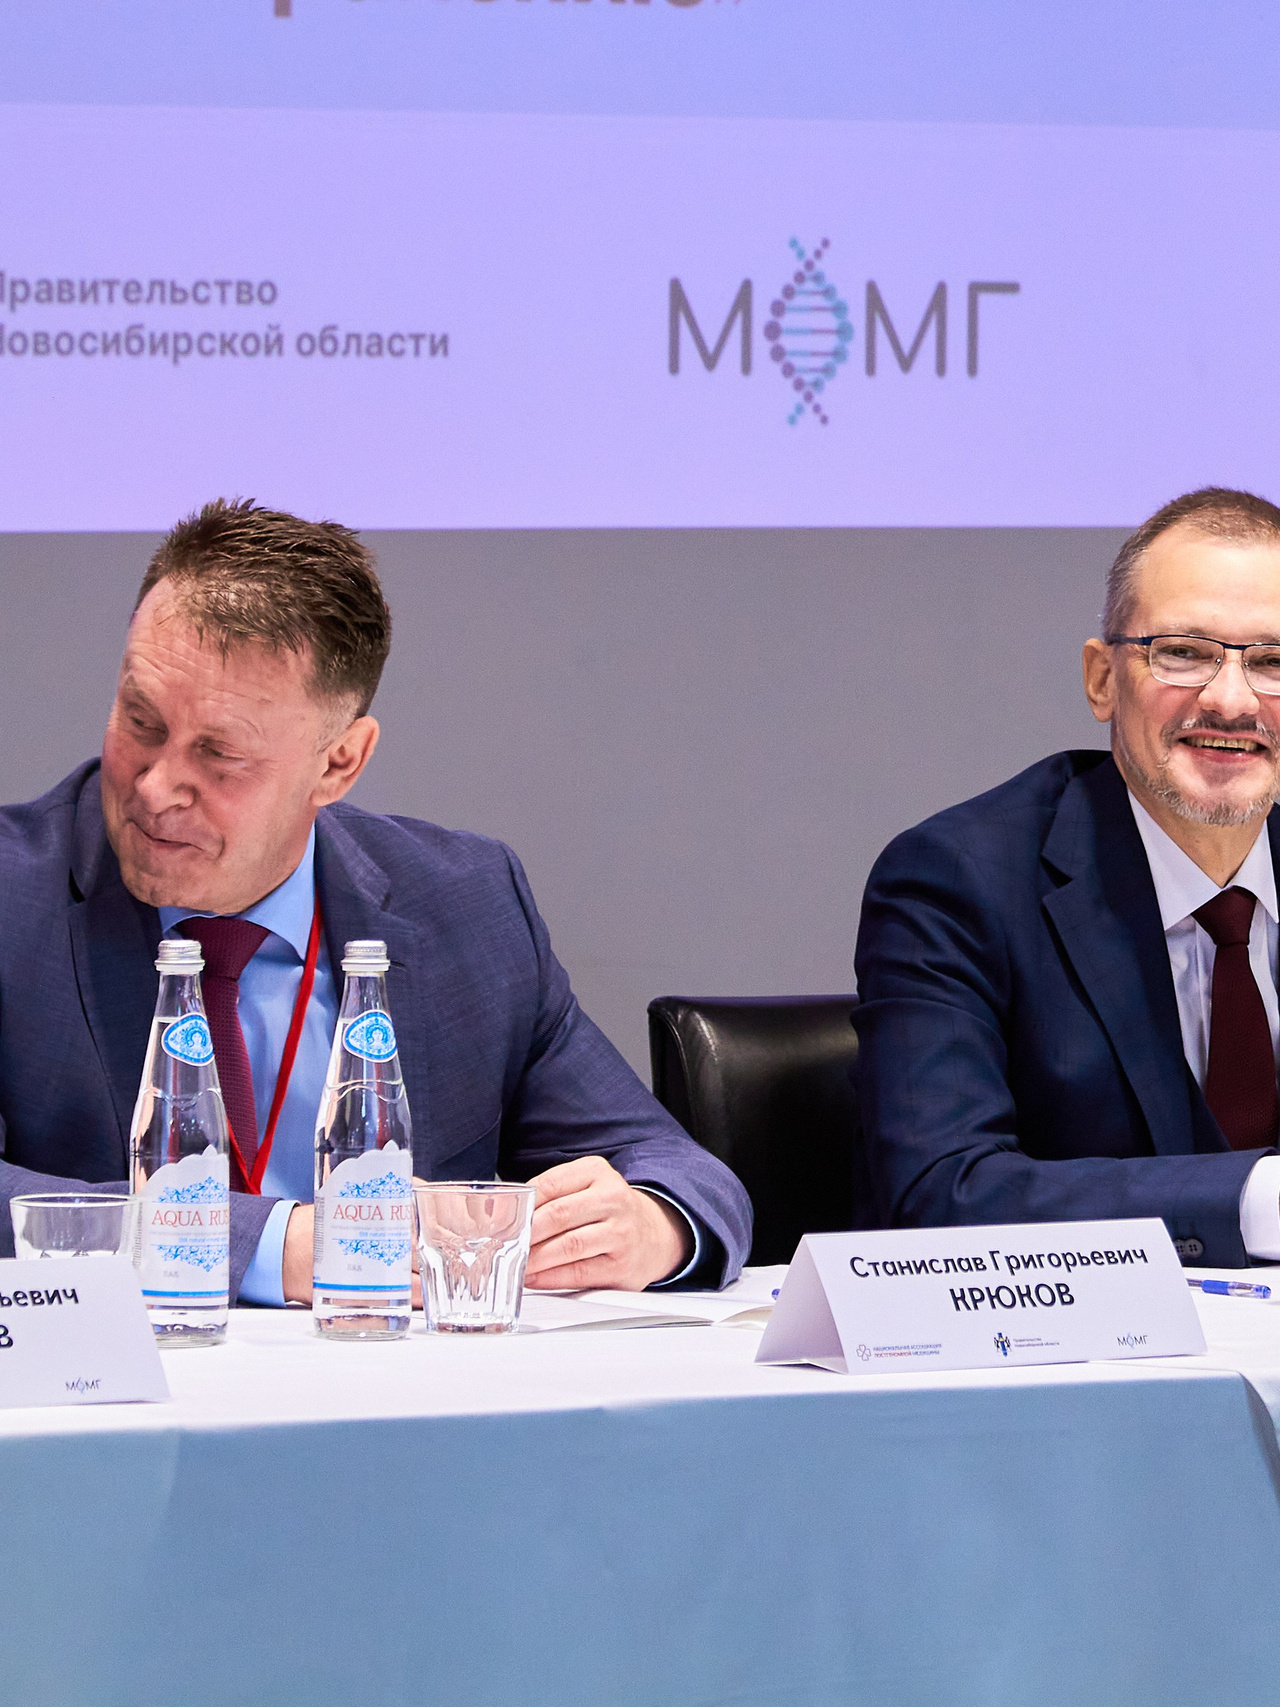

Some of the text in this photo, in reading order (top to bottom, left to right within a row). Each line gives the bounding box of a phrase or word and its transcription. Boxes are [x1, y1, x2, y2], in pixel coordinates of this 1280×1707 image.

[295, 325, 450, 358] области
[152, 1210, 203, 1228] AQUA
[333, 1204, 384, 1222] AQUA
[850, 1249, 1148, 1278] Станислав Григорьевич
[949, 1282, 1075, 1312] КРЮКОВ
